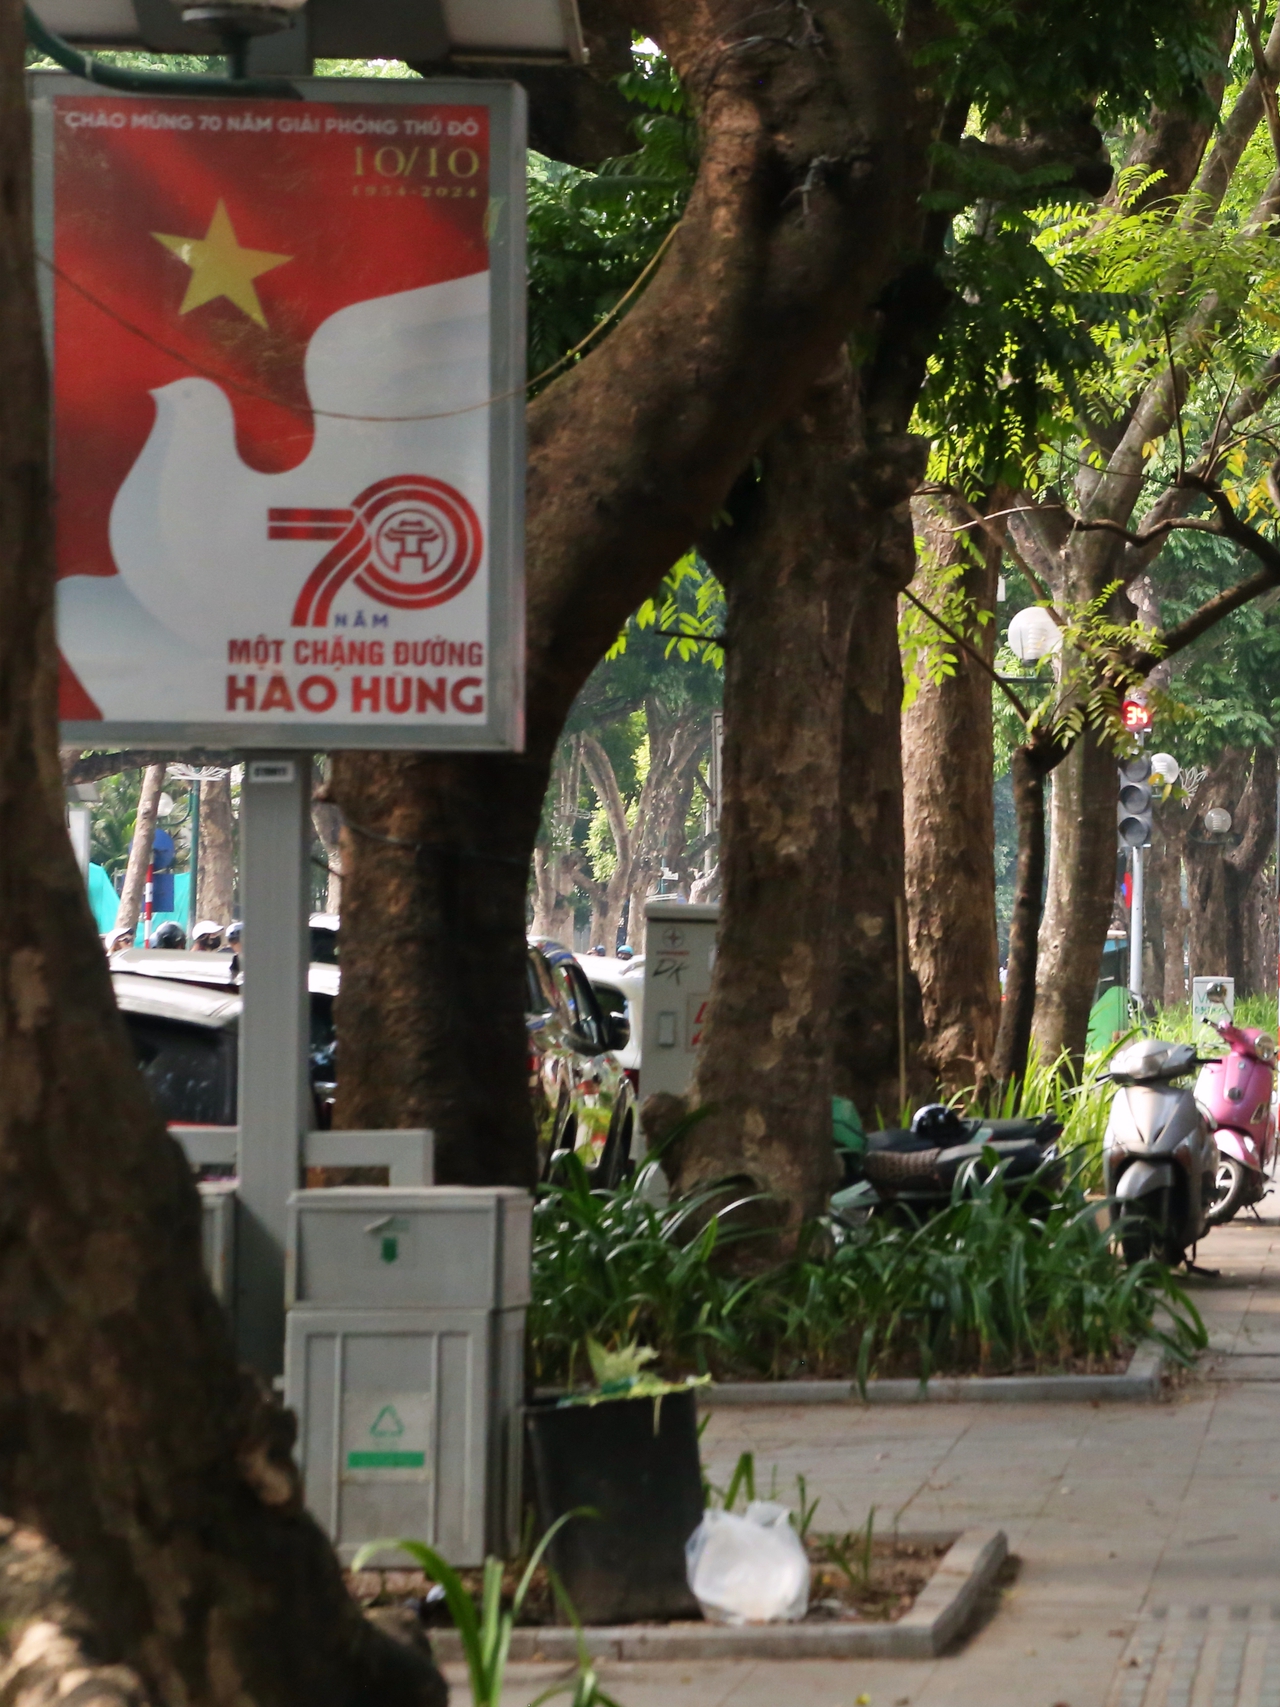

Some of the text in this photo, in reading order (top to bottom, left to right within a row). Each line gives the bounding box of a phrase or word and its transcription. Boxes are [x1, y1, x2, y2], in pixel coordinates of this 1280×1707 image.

[198, 115, 222, 131] 70
[226, 112, 273, 132] NĂM
[354, 146, 480, 178] 10/10
[267, 474, 483, 628] 70
[334, 610, 388, 628] NĂM
[228, 633, 484, 672] MỘT CHẶNG ĐƯỜNG
[226, 669, 483, 715] HÀO HÙNG
[1126, 706, 1148, 725] 34
